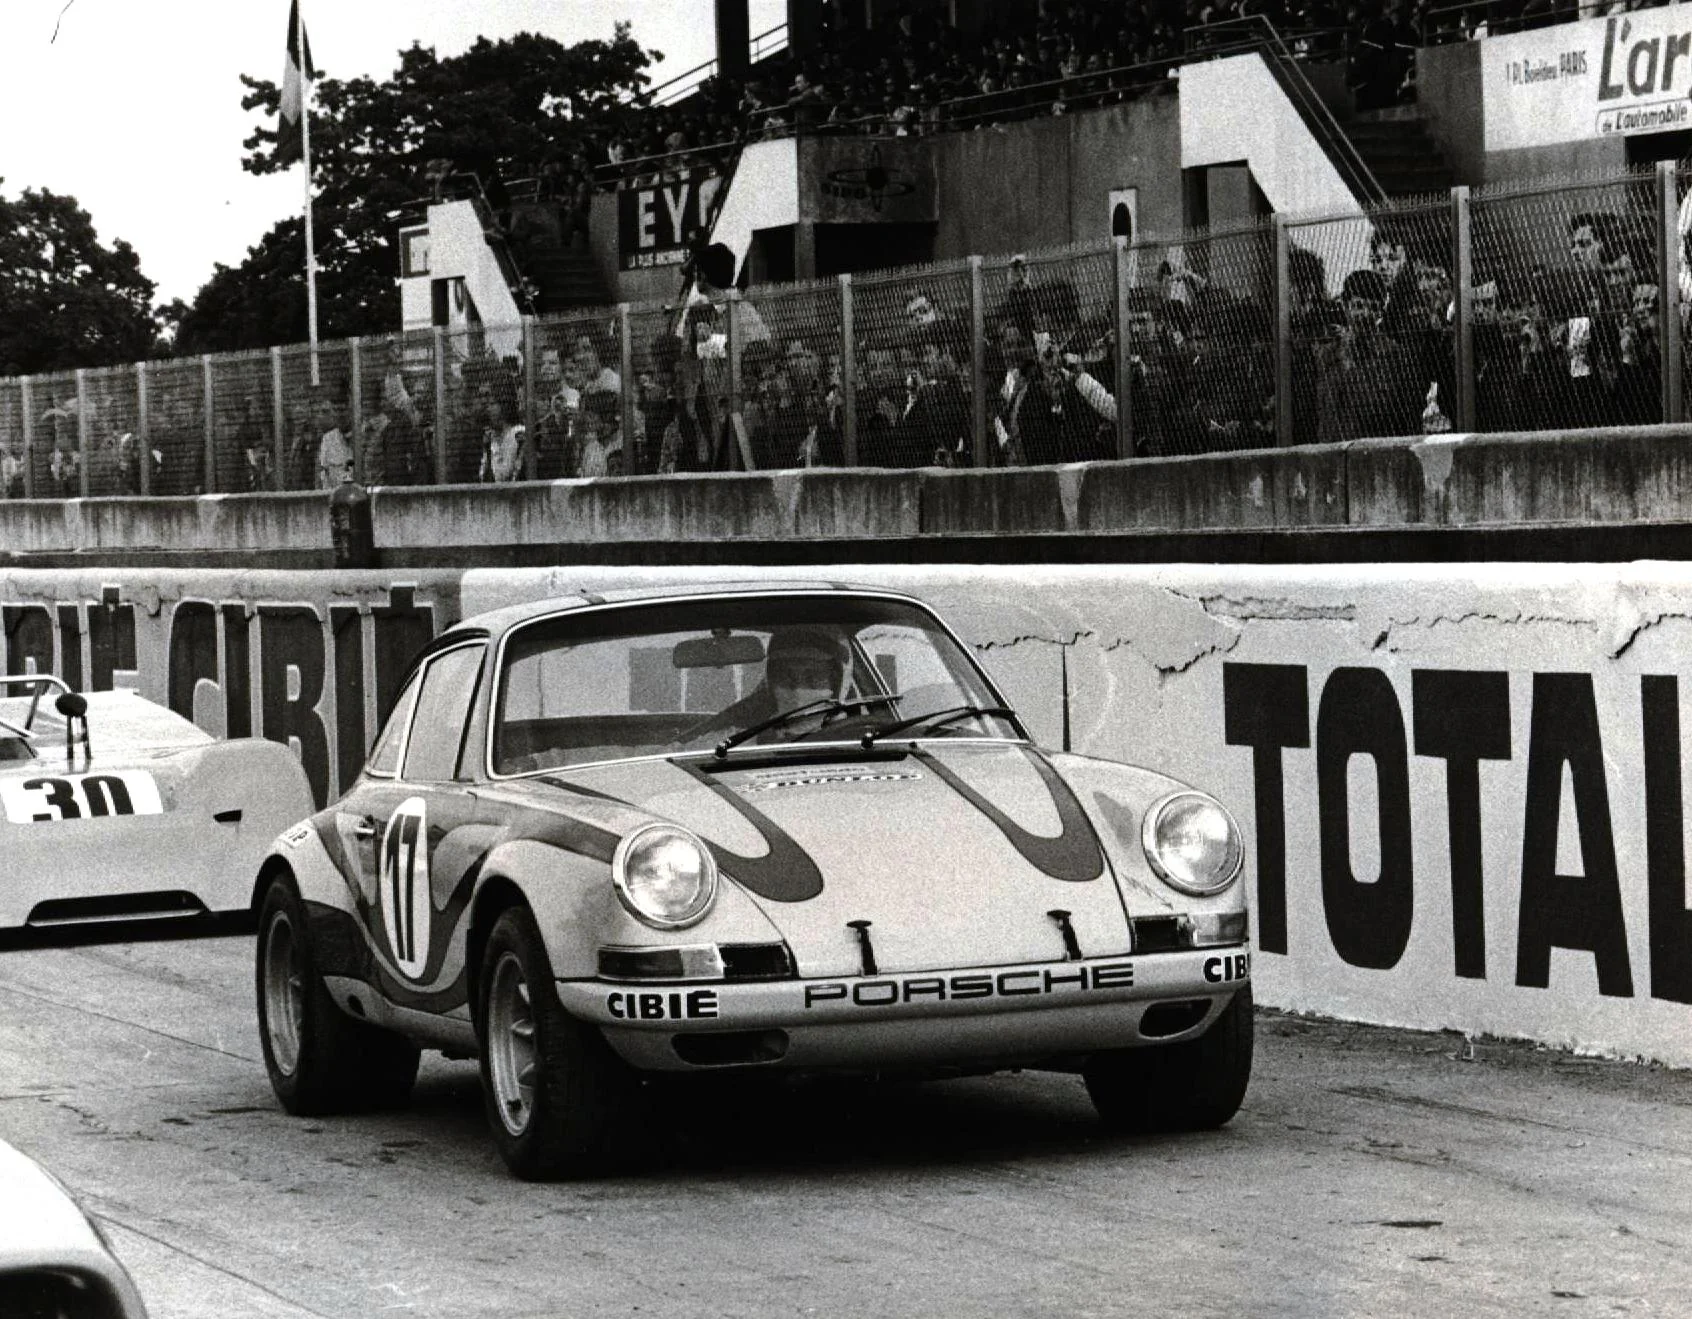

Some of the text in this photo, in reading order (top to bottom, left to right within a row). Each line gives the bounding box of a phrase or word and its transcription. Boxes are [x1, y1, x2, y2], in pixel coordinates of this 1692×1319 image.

[1598, 17, 1692, 101] L'ar
[1616, 102, 1688, 130] L'automobile
[23, 775, 135, 822] 30
[1222, 661, 1692, 1005] TOTAL
[804, 961, 1134, 1009] PORSCHE
